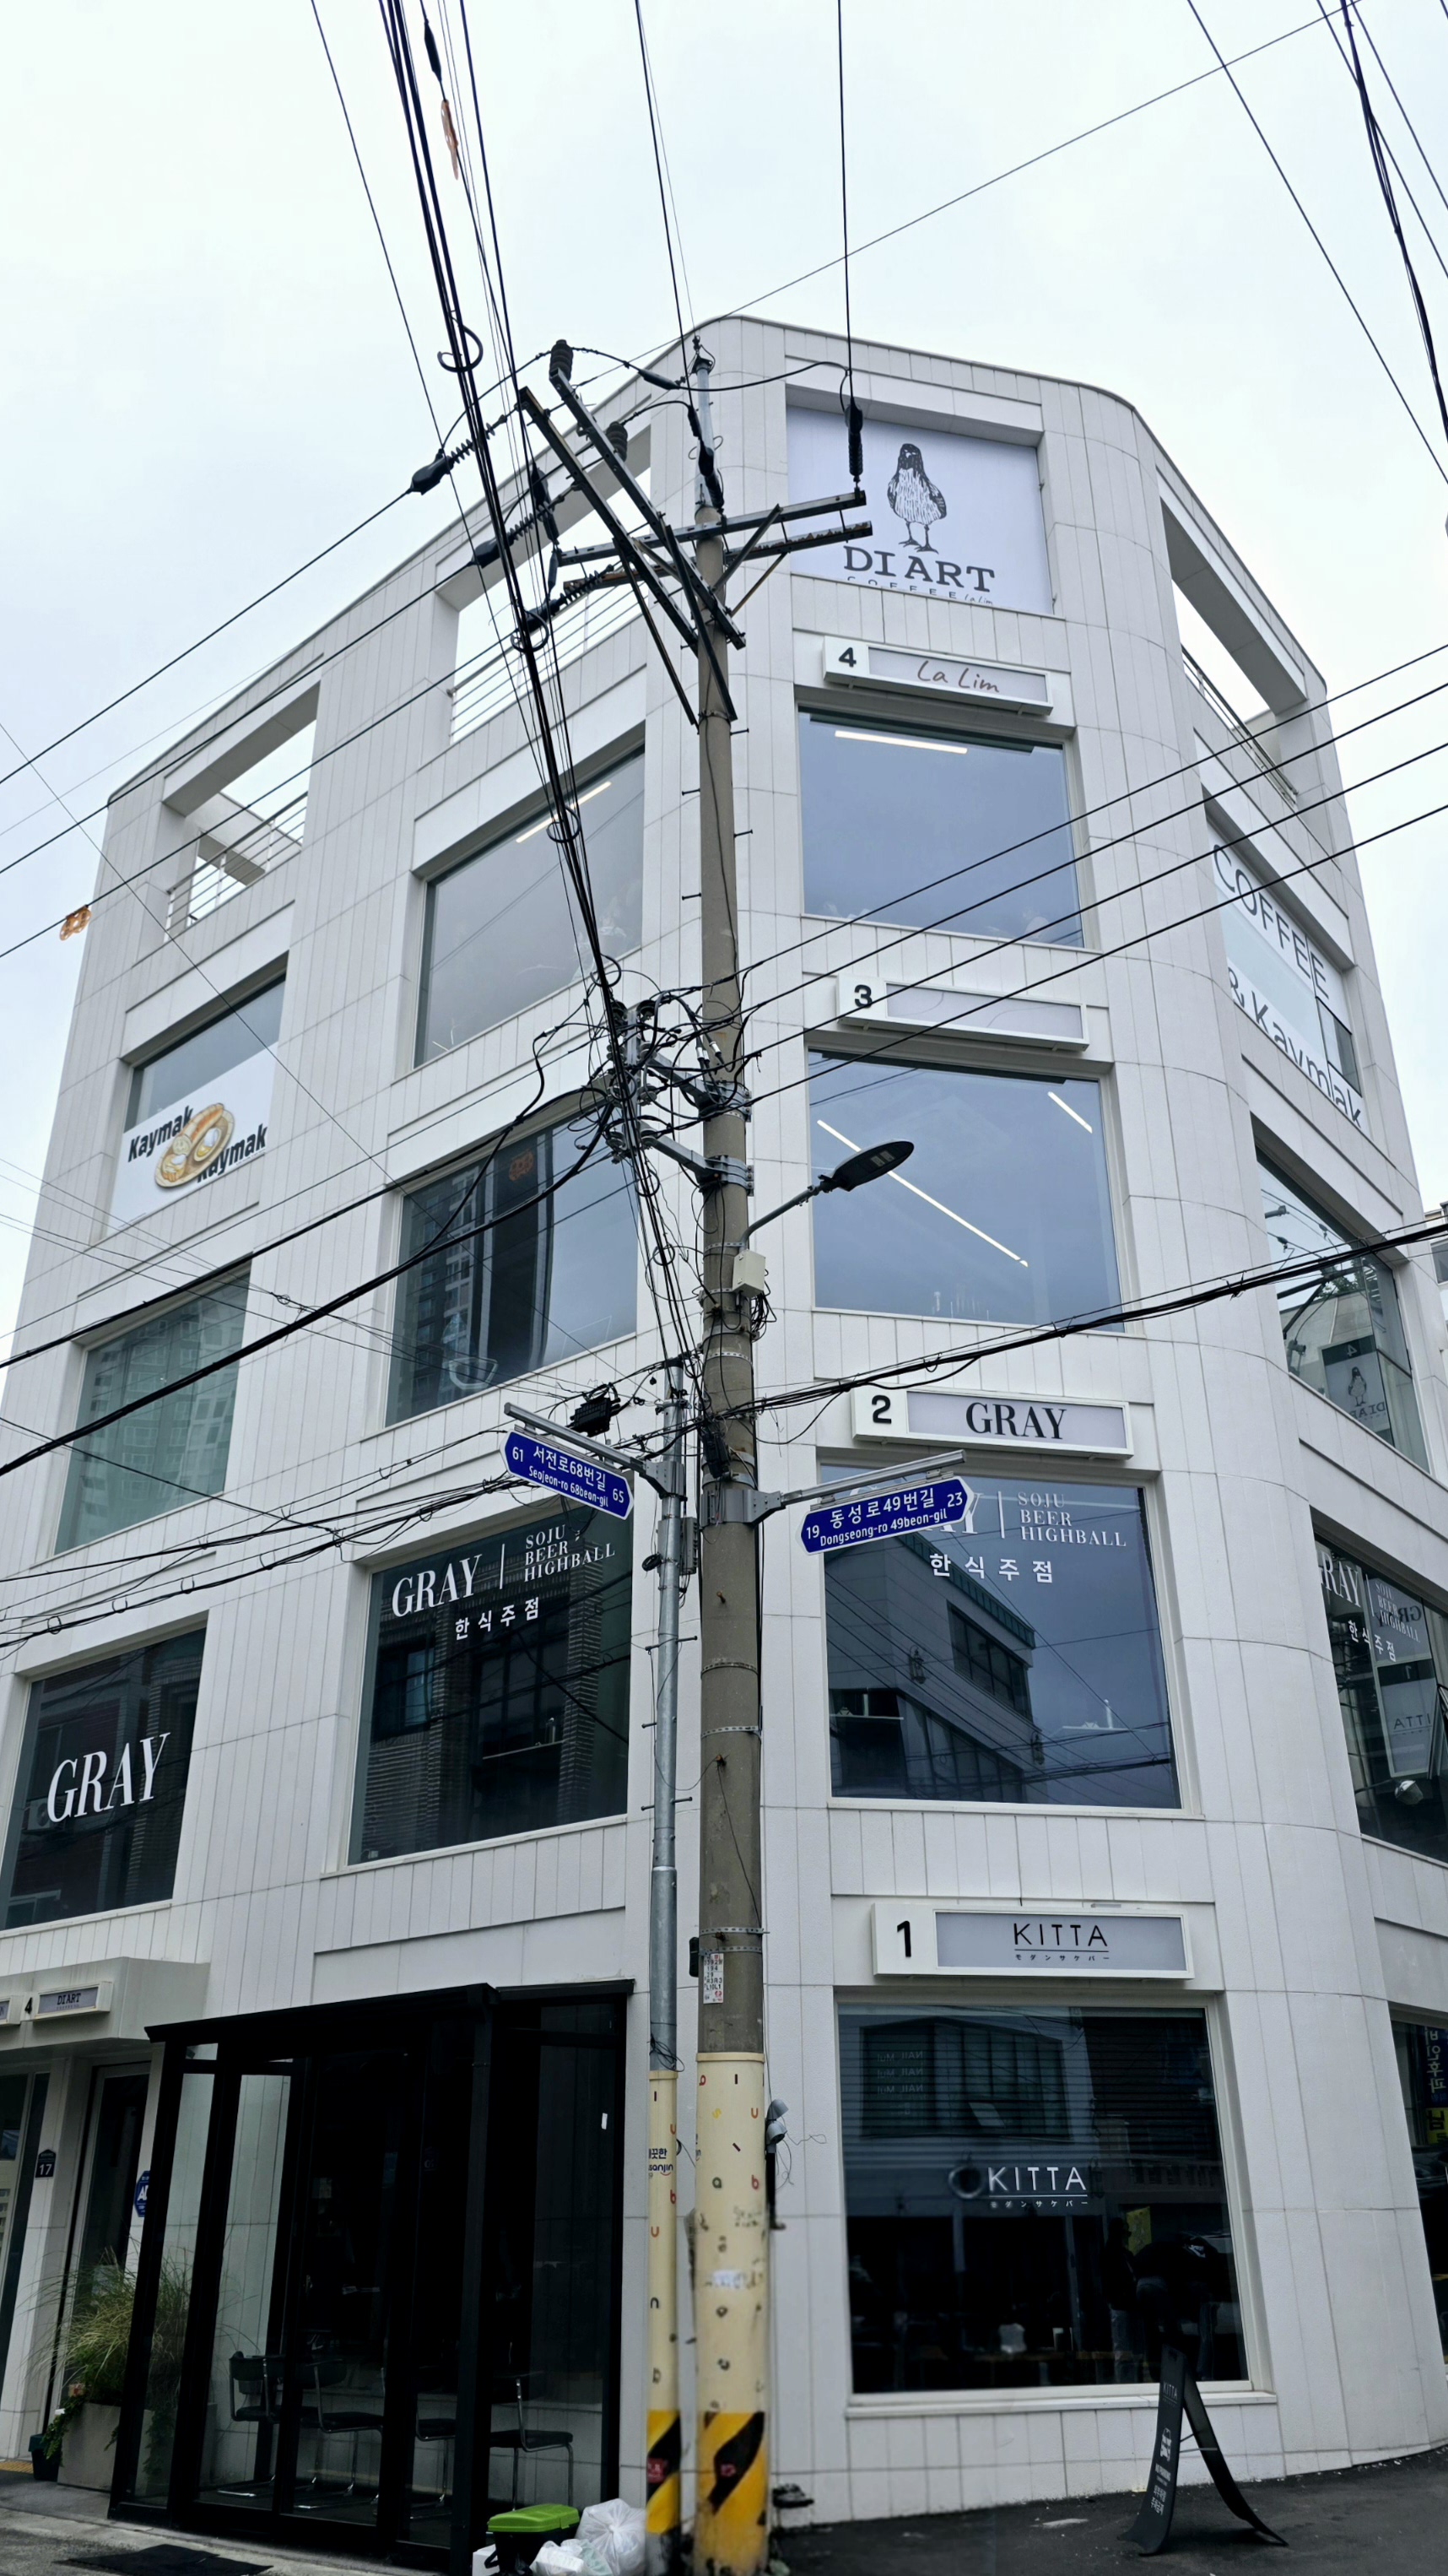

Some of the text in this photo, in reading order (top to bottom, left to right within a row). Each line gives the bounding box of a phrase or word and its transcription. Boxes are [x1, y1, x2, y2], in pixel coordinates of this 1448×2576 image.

[843, 545, 995, 593] DIART
[838, 647, 857, 668] 4
[958, 667, 1000, 693] Lim
[1213, 844, 1330, 1000] COFFEE
[853, 983, 873, 1009] 3
[128, 1105, 194, 1163] Kaymak
[871, 1394, 893, 1425] 2
[965, 1401, 1067, 1440] GRAY
[512, 1447, 524, 1463] 61
[533, 1446, 607, 1492] 서전로68번길
[529, 1465, 609, 1507] Seojeon-ro 68beon-gil
[613, 1488, 624, 1504] 65
[829, 1487, 935, 1529] 동성로49번길
[947, 1491, 963, 1508] 23
[1018, 1491, 1066, 1508] SOJU
[820, 1523, 888, 1546] Dongseong-ro
[890, 1508, 948, 1529] 49beon-gil
[1020, 1509, 1072, 1527] BEER
[526, 1524, 566, 1550] SOJU
[806, 1524, 820, 1540] 19
[1021, 1526, 1127, 1547] HIGHBALL
[524, 1543, 615, 1583] HIGHBALL
[525, 1540, 569, 1566] BEER
[929, 1553, 1053, 1583] 한식주점
[1320, 1550, 1361, 1608] RAY
[392, 1554, 483, 1618] GRAY
[455, 1596, 539, 1641] 한식주점
[47, 1732, 170, 1823] GRAY
[896, 1920, 912, 1957] 1
[1013, 1923, 1108, 1947] KITTA
[57, 1993, 82, 2005] DIART
[649, 2147, 667, 2160] 끗한
[39, 2163, 52, 2176] 17
[988, 2167, 1087, 2192] KITTA
